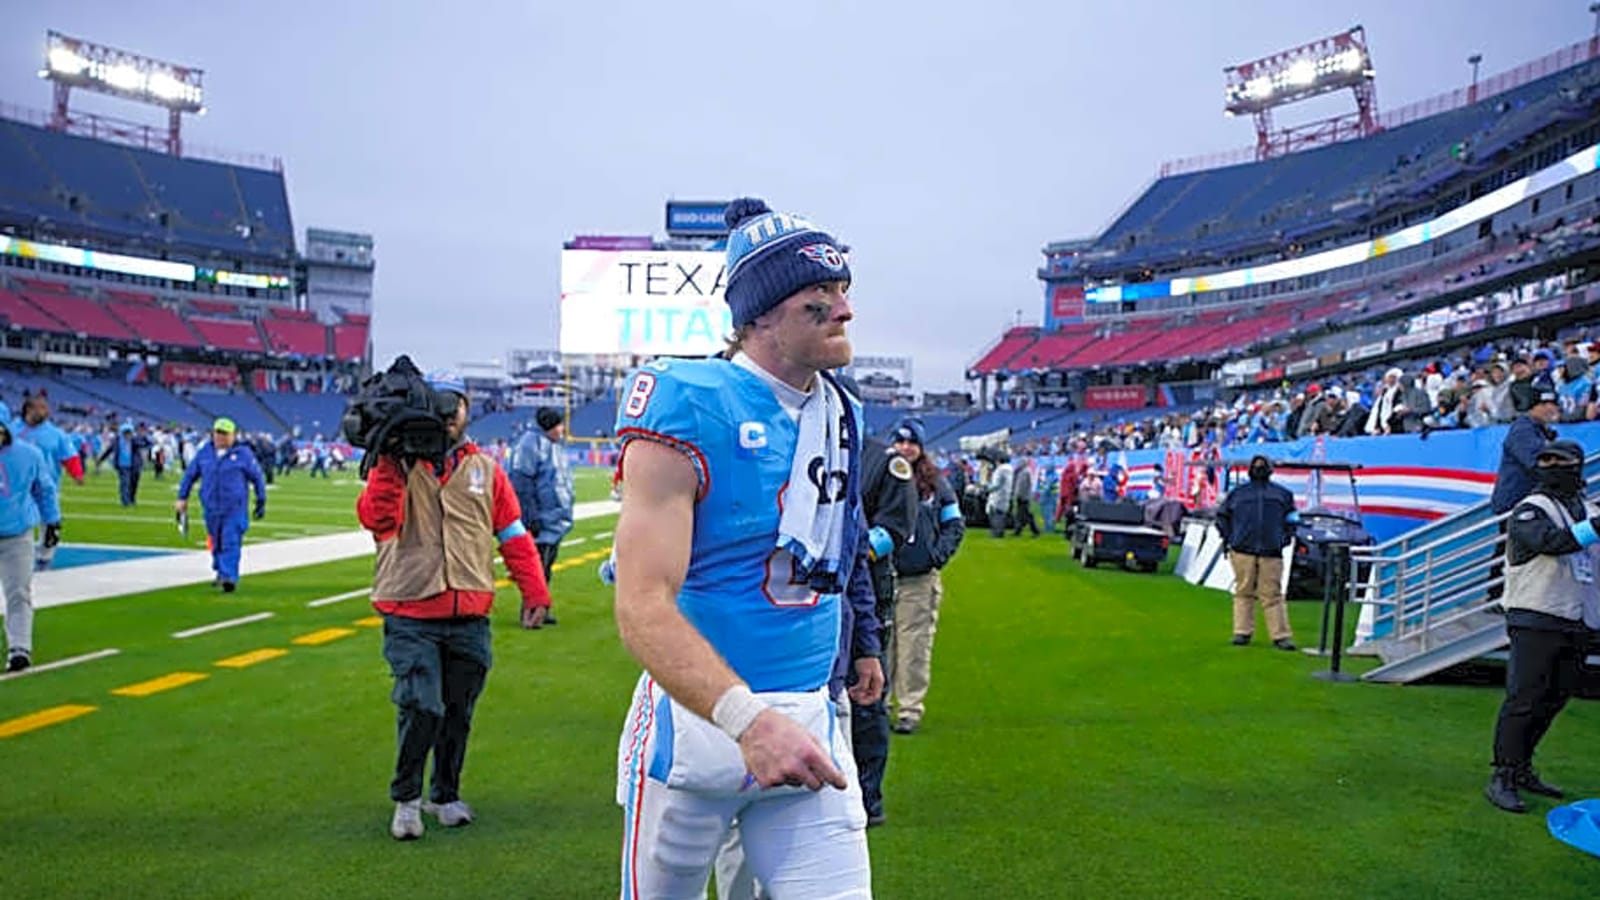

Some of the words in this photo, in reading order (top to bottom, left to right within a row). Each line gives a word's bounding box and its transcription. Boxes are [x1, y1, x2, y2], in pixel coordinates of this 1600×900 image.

[624, 371, 657, 419] 8
[1092, 390, 1139, 400] NISSAN
[738, 421, 768, 449] C
